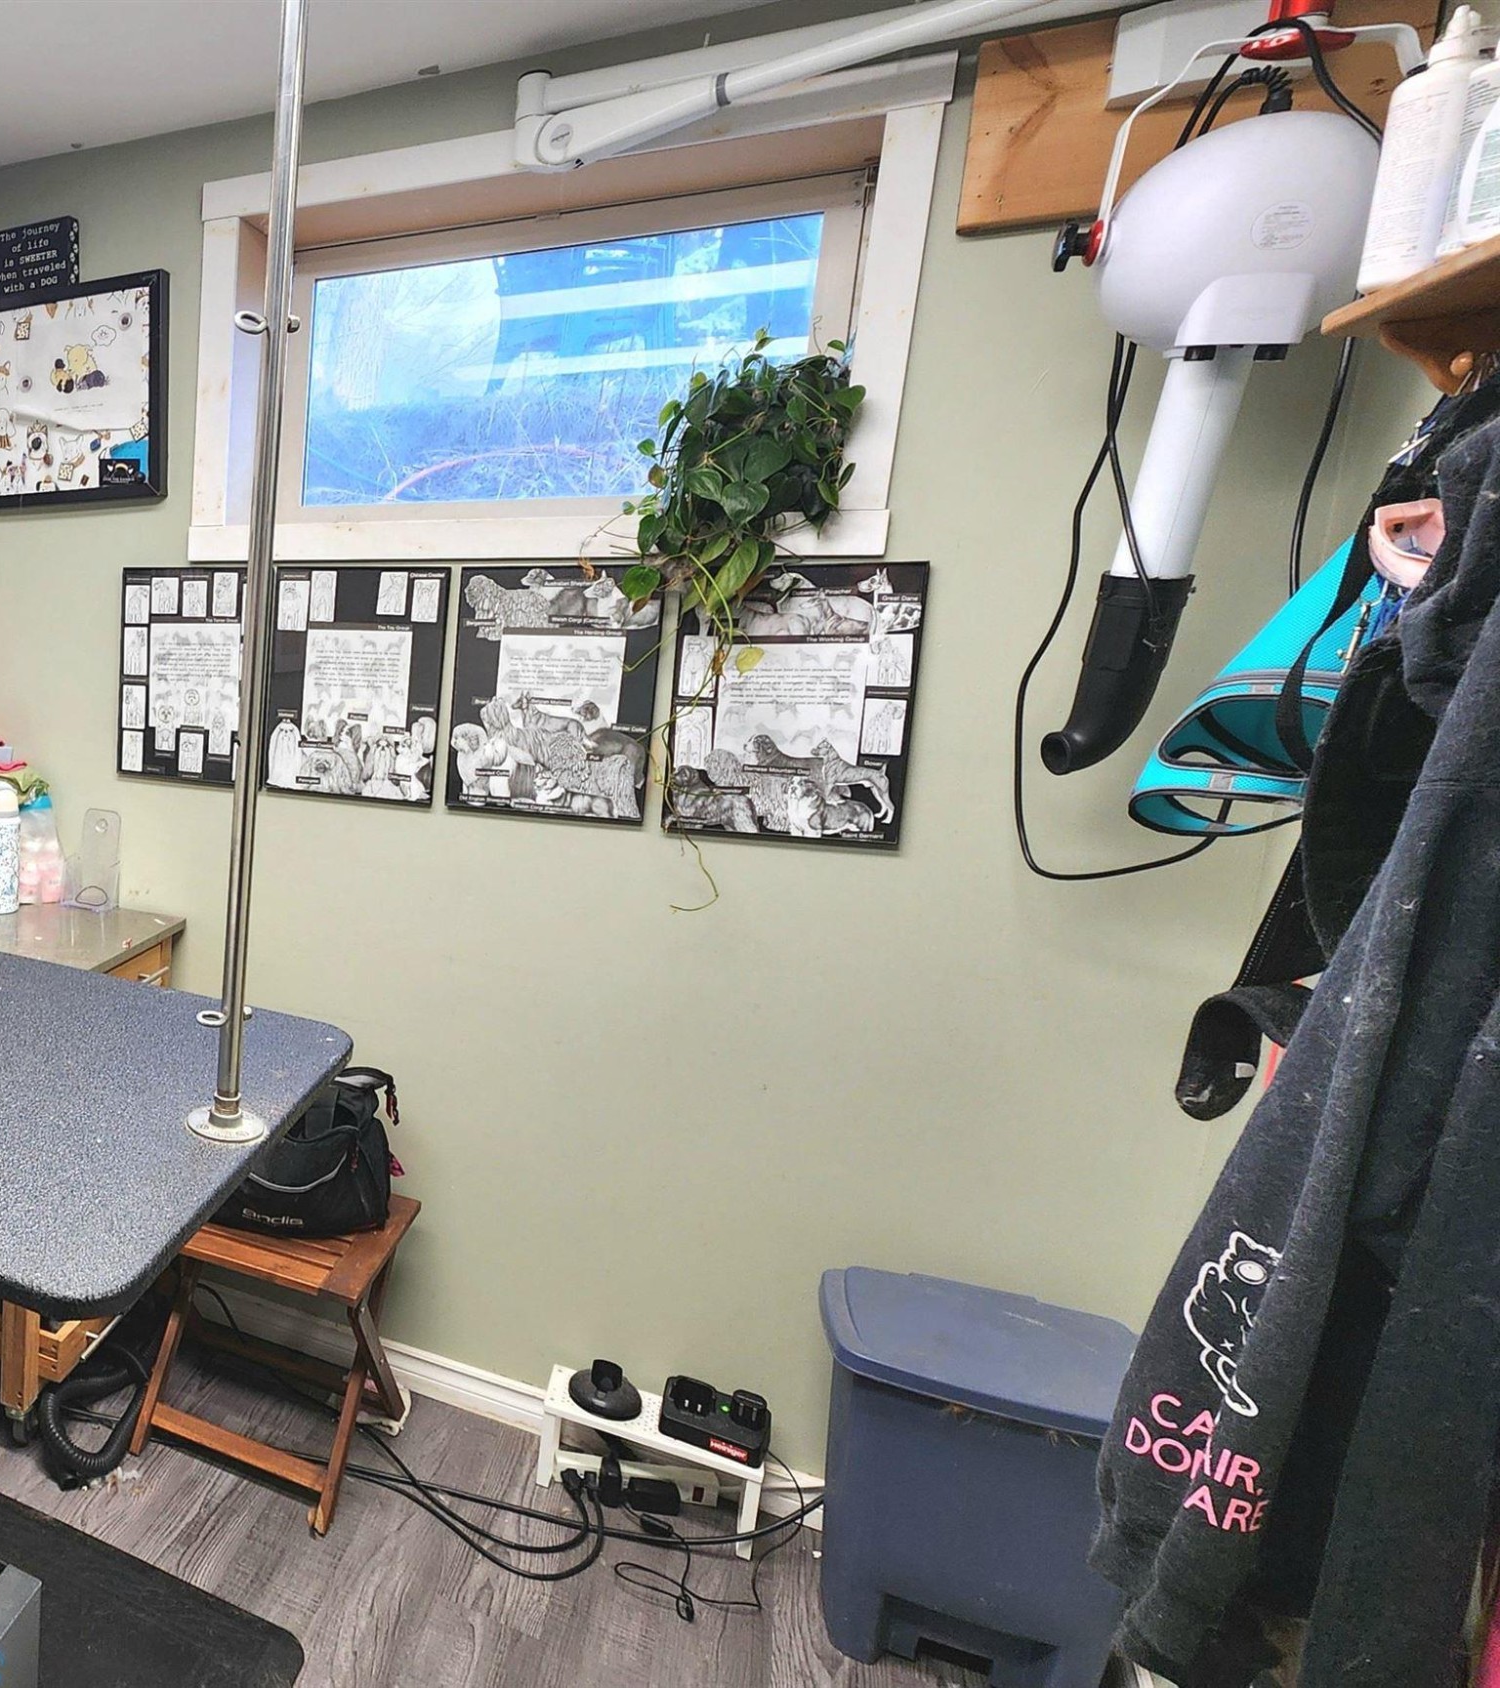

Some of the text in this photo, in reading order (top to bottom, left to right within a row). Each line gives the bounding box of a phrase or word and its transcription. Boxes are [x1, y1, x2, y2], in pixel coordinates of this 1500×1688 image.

[0, 222, 60, 242] The journey
[11, 238, 49, 253] of life
[4, 249, 58, 268] is SWEETER
[22, 260, 67, 277] traveled
[4, 282, 25, 294] with
[41, 276, 58, 287] DOG
